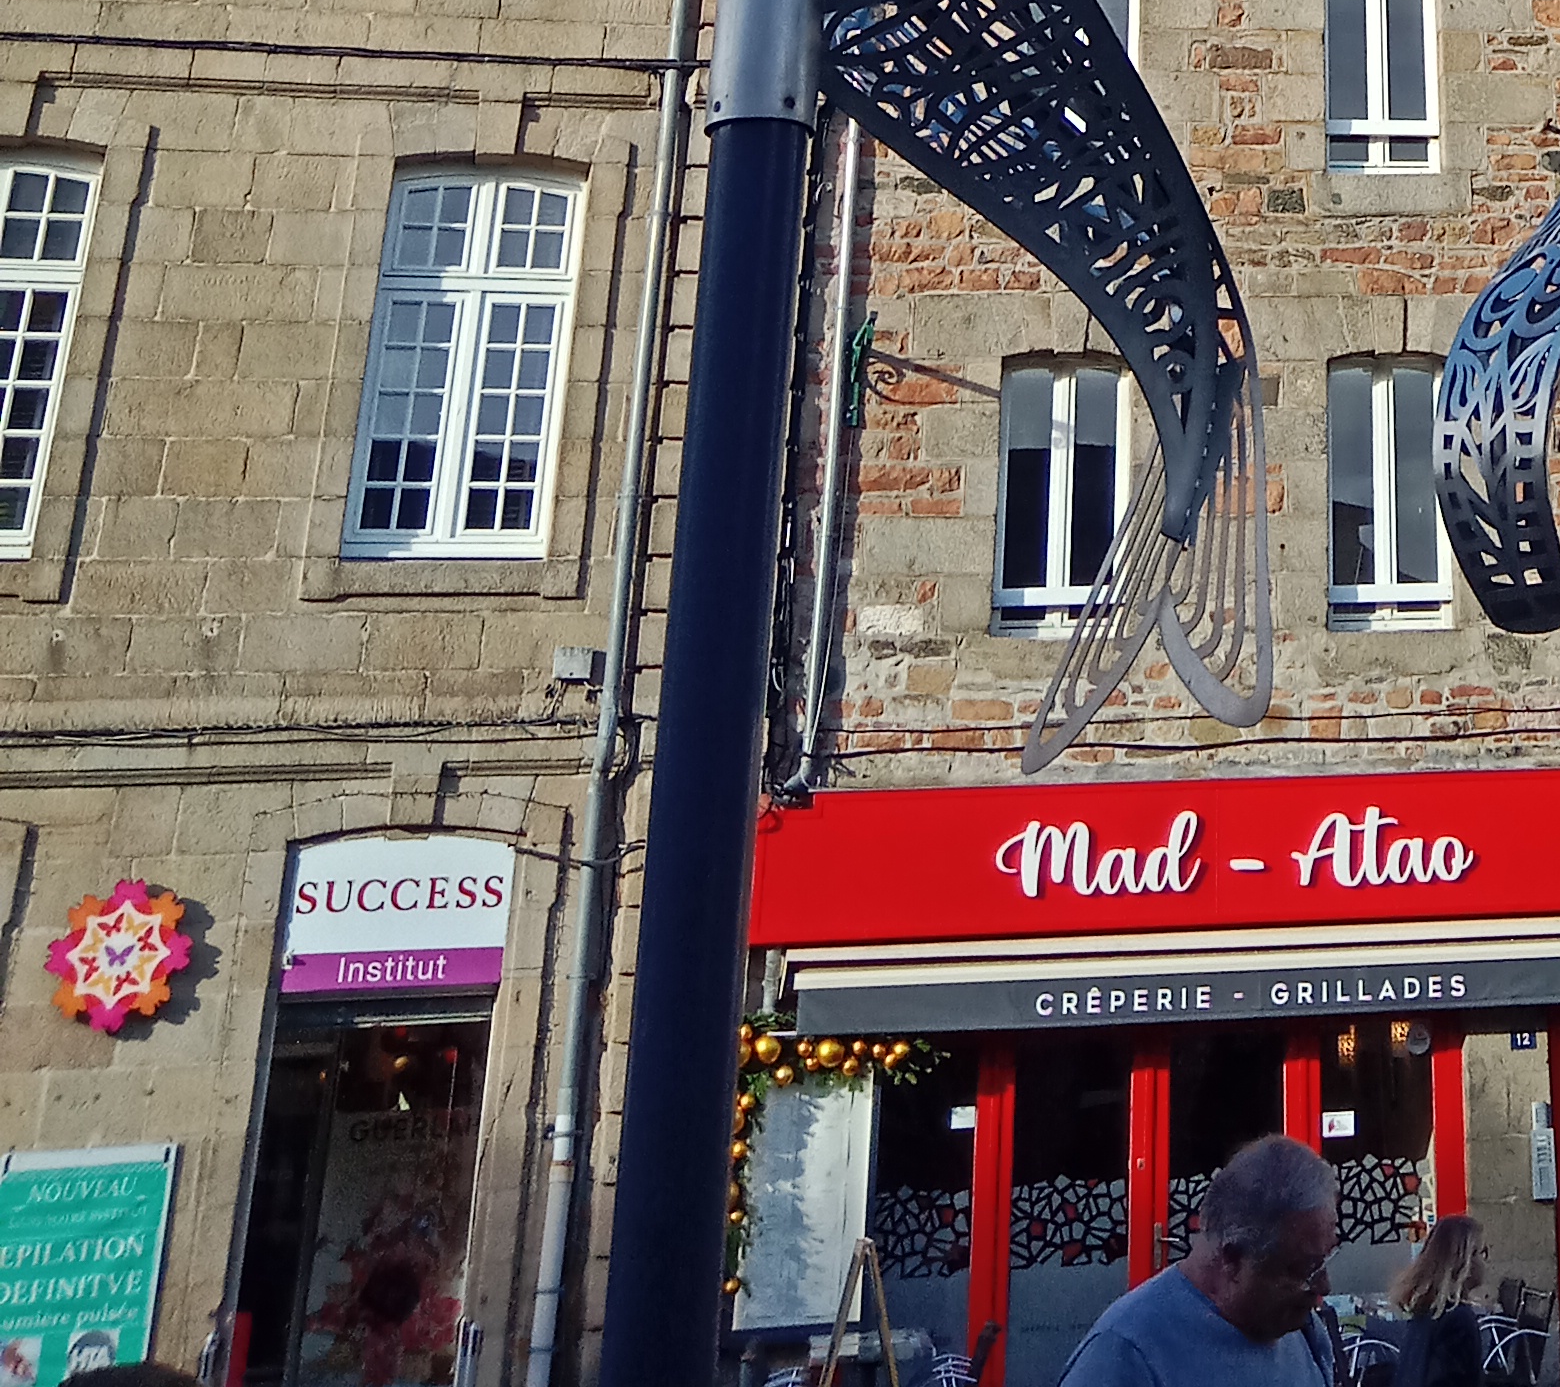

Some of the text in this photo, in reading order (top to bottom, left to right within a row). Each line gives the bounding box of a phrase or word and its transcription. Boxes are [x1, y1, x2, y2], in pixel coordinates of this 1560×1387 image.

[995, 810, 1201, 898] Mad
[1290, 806, 1474, 887] Atao
[295, 875, 505, 914] SUCCESS
[336, 954, 447, 983] Institut
[1035, 984, 1212, 1017] CRÊPERIE
[1271, 974, 1467, 1006] GRILLADES
[1516, 1032, 1529, 1046] 12
[27, 1176, 137, 1203] NOUVEAU
[0, 1235, 145, 1269] EPILATION
[0, 1270, 142, 1304] DEFINITVE
